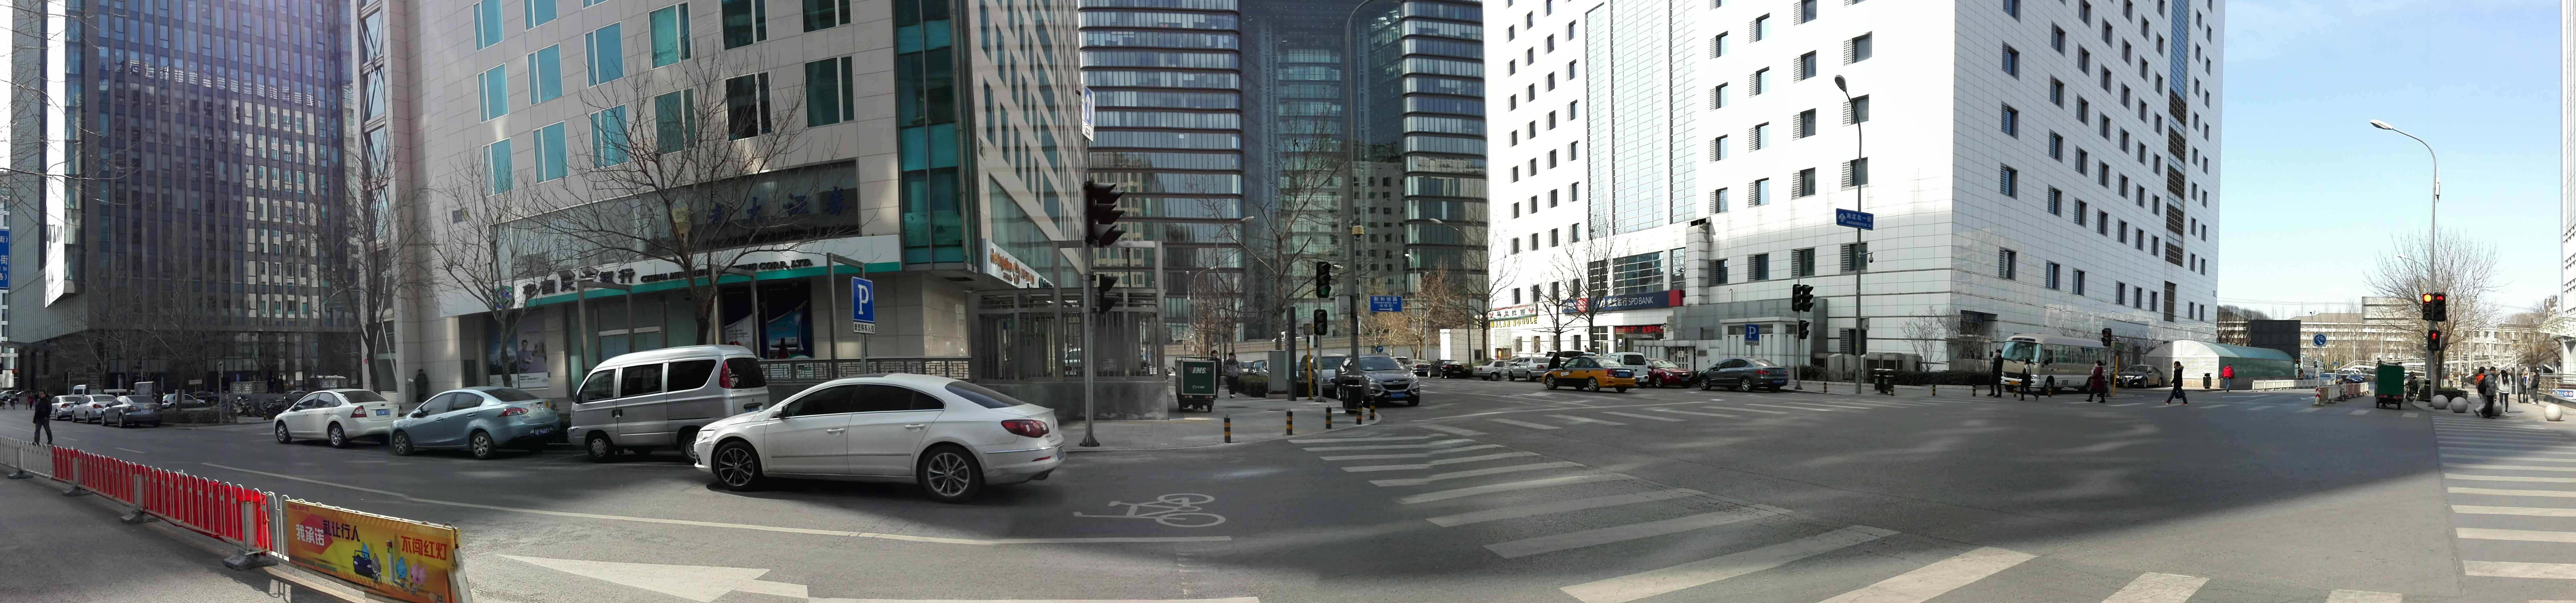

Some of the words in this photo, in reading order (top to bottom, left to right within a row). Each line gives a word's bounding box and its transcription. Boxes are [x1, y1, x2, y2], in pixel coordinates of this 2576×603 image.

[1846, 213, 1871, 222] 海淀北一街
[522, 268, 635, 296] 中国民银行
[641, 273, 668, 283] CHINA
[790, 259, 813, 268] LTD.
[858, 284, 869, 315] P
[854, 323, 874, 332] 请您停车入位
[1513, 316, 1537, 327] NOODLE
[1748, 326, 1756, 338] P
[295, 524, 325, 546] 我承诺
[323, 520, 360, 542] 礼让行人
[401, 536, 447, 561] 不闯红灯
